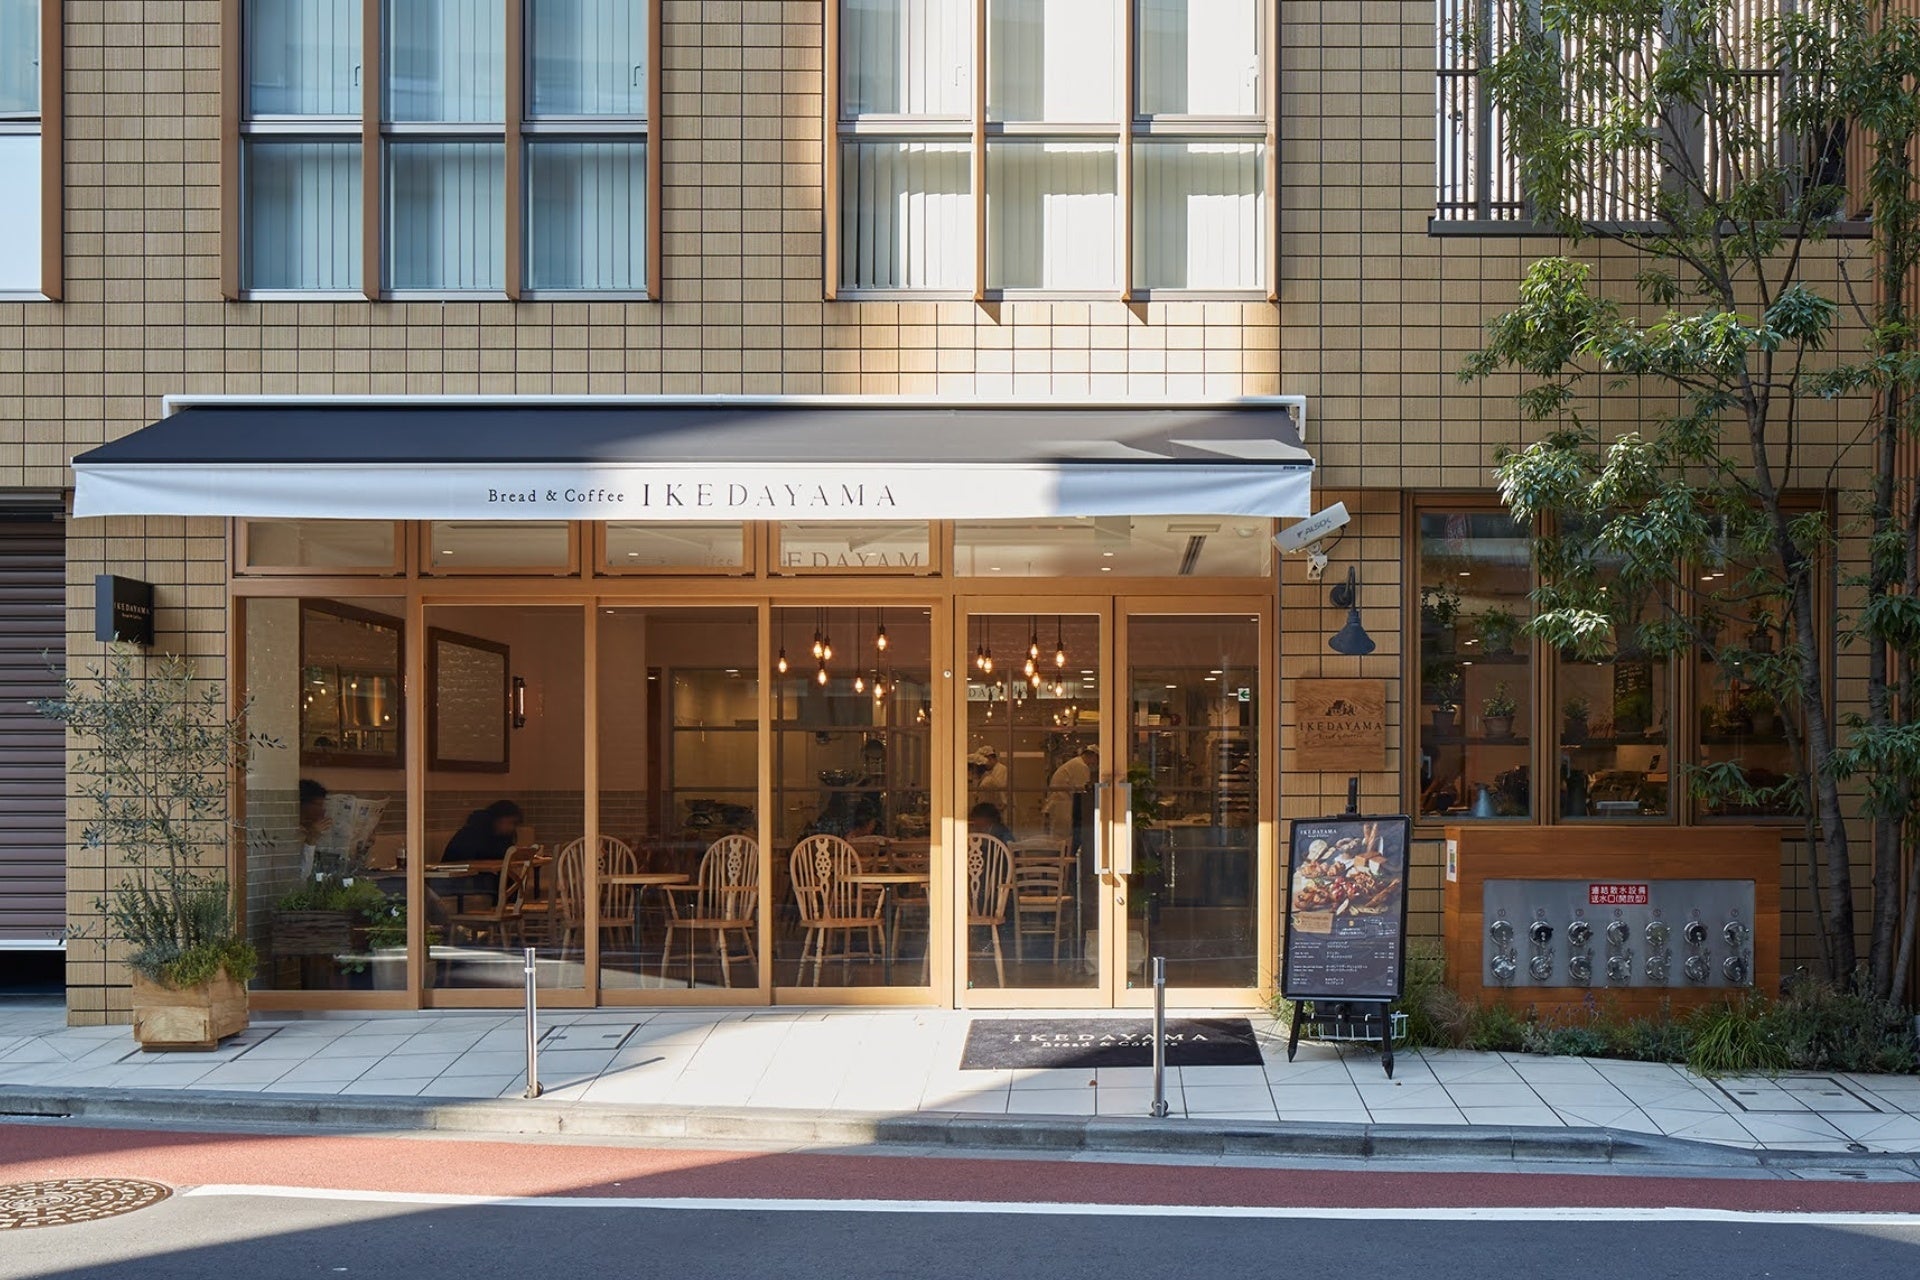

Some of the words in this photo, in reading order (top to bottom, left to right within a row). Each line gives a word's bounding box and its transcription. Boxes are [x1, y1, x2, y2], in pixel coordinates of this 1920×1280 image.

[488, 489, 537, 502] Bread
[545, 490, 557, 502] &
[564, 488, 624, 502] Coffee
[643, 483, 896, 506] IKEDAYAMA
[1300, 721, 1382, 731] IKEDAYAMA
[1012, 1034, 1209, 1042] IKEDAYAMA
